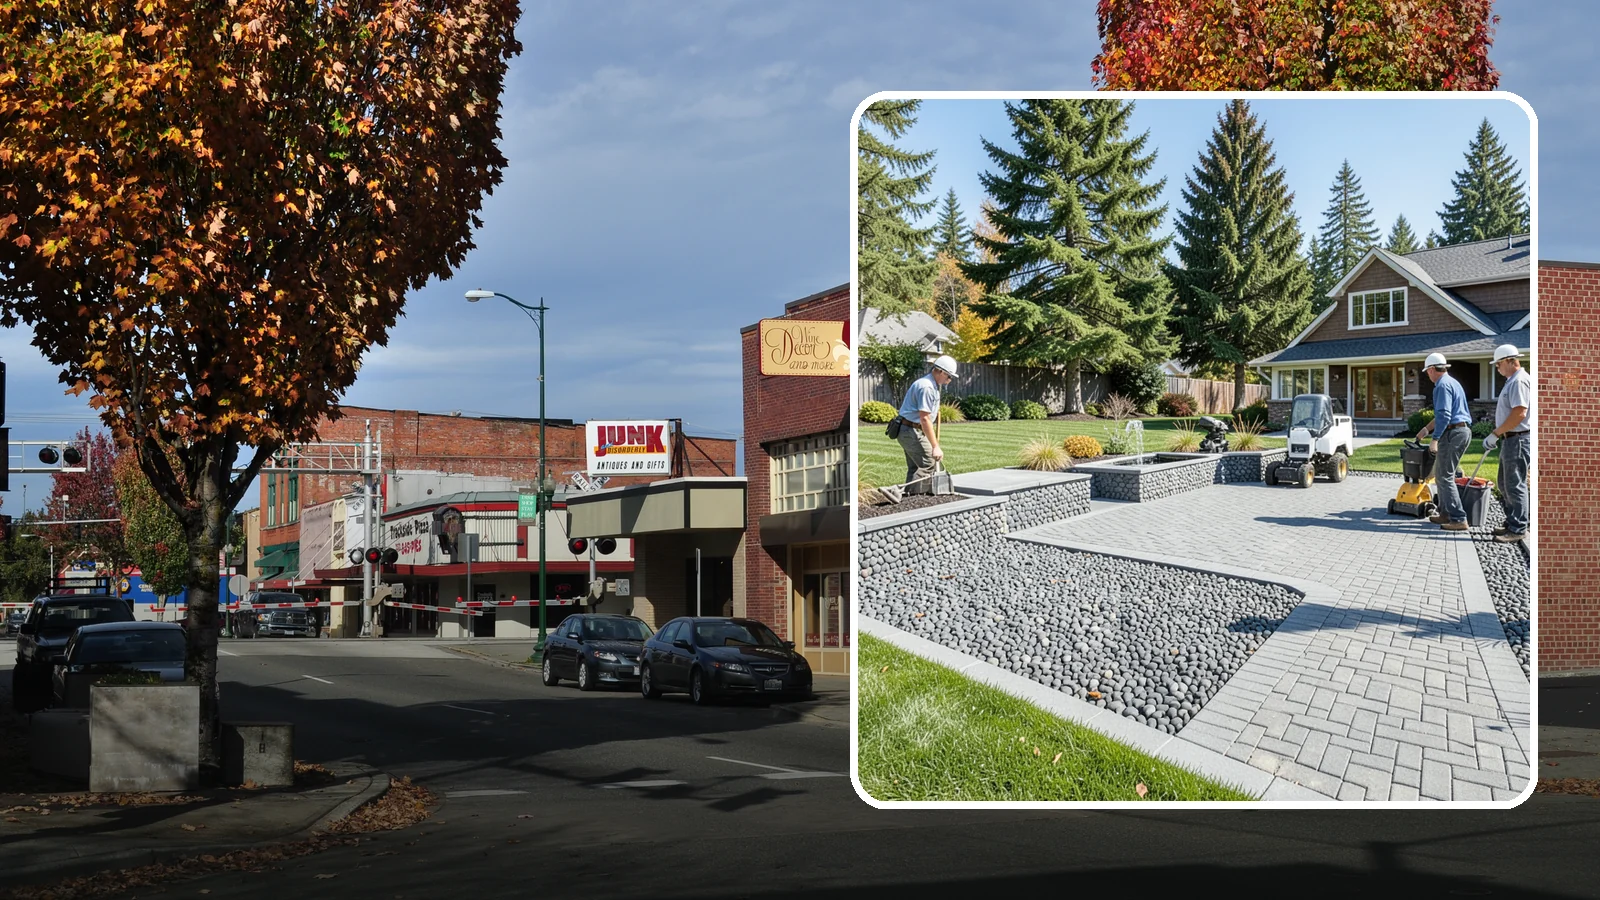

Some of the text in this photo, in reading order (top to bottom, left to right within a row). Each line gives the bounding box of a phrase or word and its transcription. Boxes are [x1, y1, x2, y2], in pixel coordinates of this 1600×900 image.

[595, 425, 664, 457] JUNK
[607, 446, 645, 454] DISORDERLY
[597, 460, 665, 470] ANTIQUES AND GIFTS
[352, 498, 365, 511] CRO
[390, 519, 429, 540] Trackside Pizza
